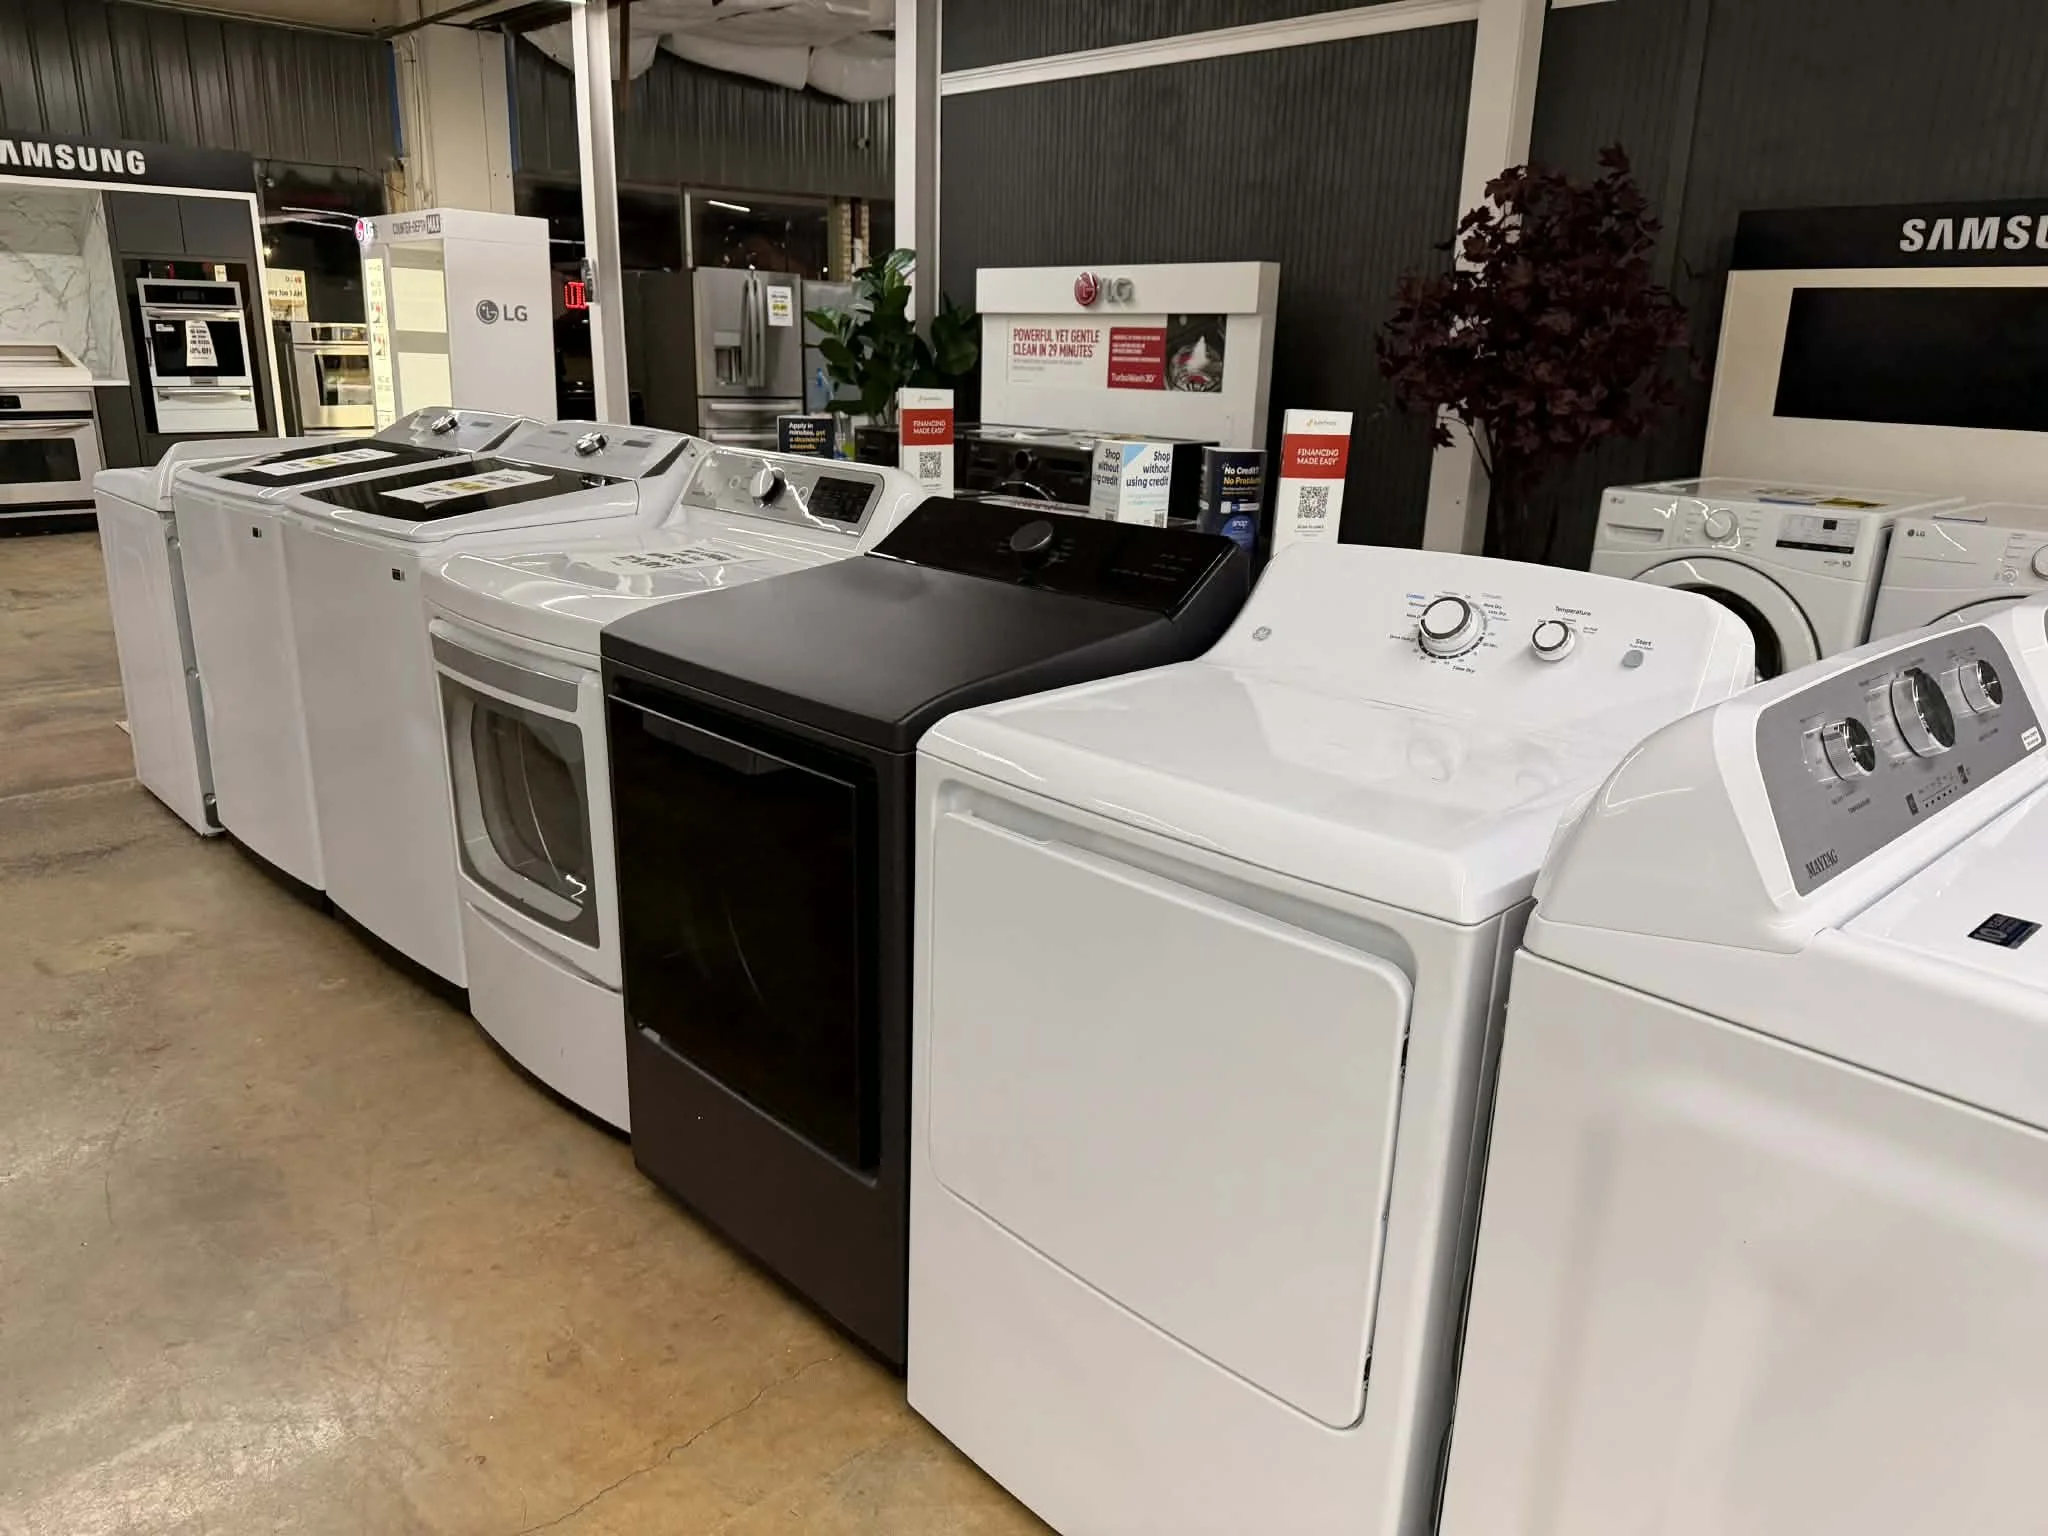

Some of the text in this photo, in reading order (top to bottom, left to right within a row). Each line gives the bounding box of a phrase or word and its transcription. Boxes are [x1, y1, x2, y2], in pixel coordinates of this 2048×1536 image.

[1103, 277, 1135, 304] LG
[503, 304, 528, 322] LG
[1012, 327, 1100, 344] POWERFUL YET GENTLE
[1012, 343, 1038, 357] CLEAN
[1038, 344, 1048, 357] IN
[1048, 344, 1058, 357] 29
[788, 421, 807, 432] Apply
[912, 419, 946, 428] FINANCING
[1104, 448, 1121, 461] Shop
[1153, 450, 1171, 462] Shop
[1297, 448, 1339, 457] FINANCING
[1296, 457, 1318, 465] MADE
[1142, 463, 1171, 475] without
[1224, 466, 1236, 475] No
[1101, 473, 1118, 487] credit
[1126, 476, 1169, 489] using credit
[1223, 476, 1236, 485] No
[1554, 605, 1592, 617] Temperature
[1635, 637, 1652, 646] Start
[1805, 849, 1839, 880] MAYTAG
